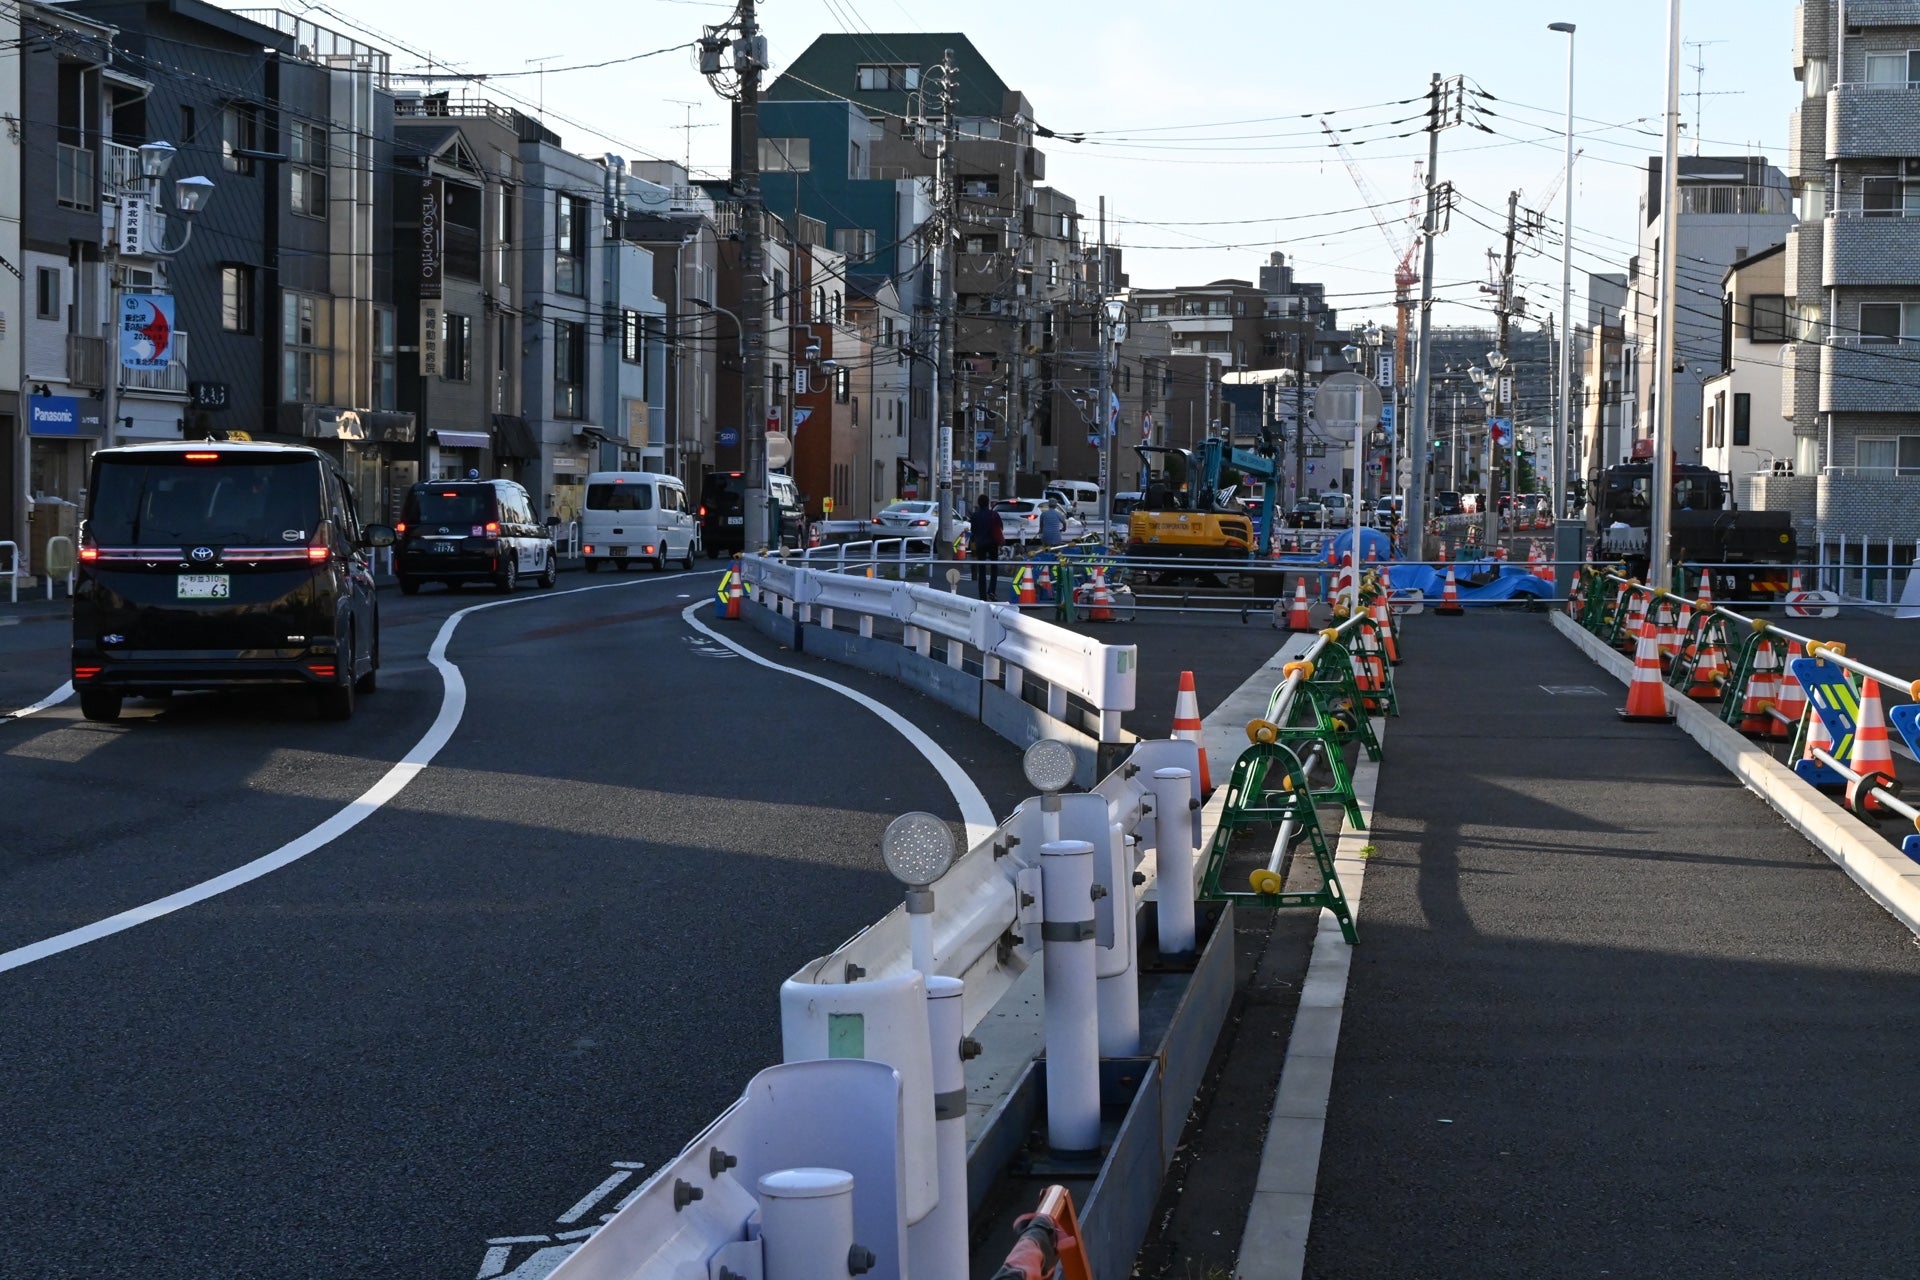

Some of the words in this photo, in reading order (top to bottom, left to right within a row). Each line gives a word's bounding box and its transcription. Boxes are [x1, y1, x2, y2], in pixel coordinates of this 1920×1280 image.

[126, 200, 138, 253] 東北沢商和会
[34, 407, 73, 423] Panasonic
